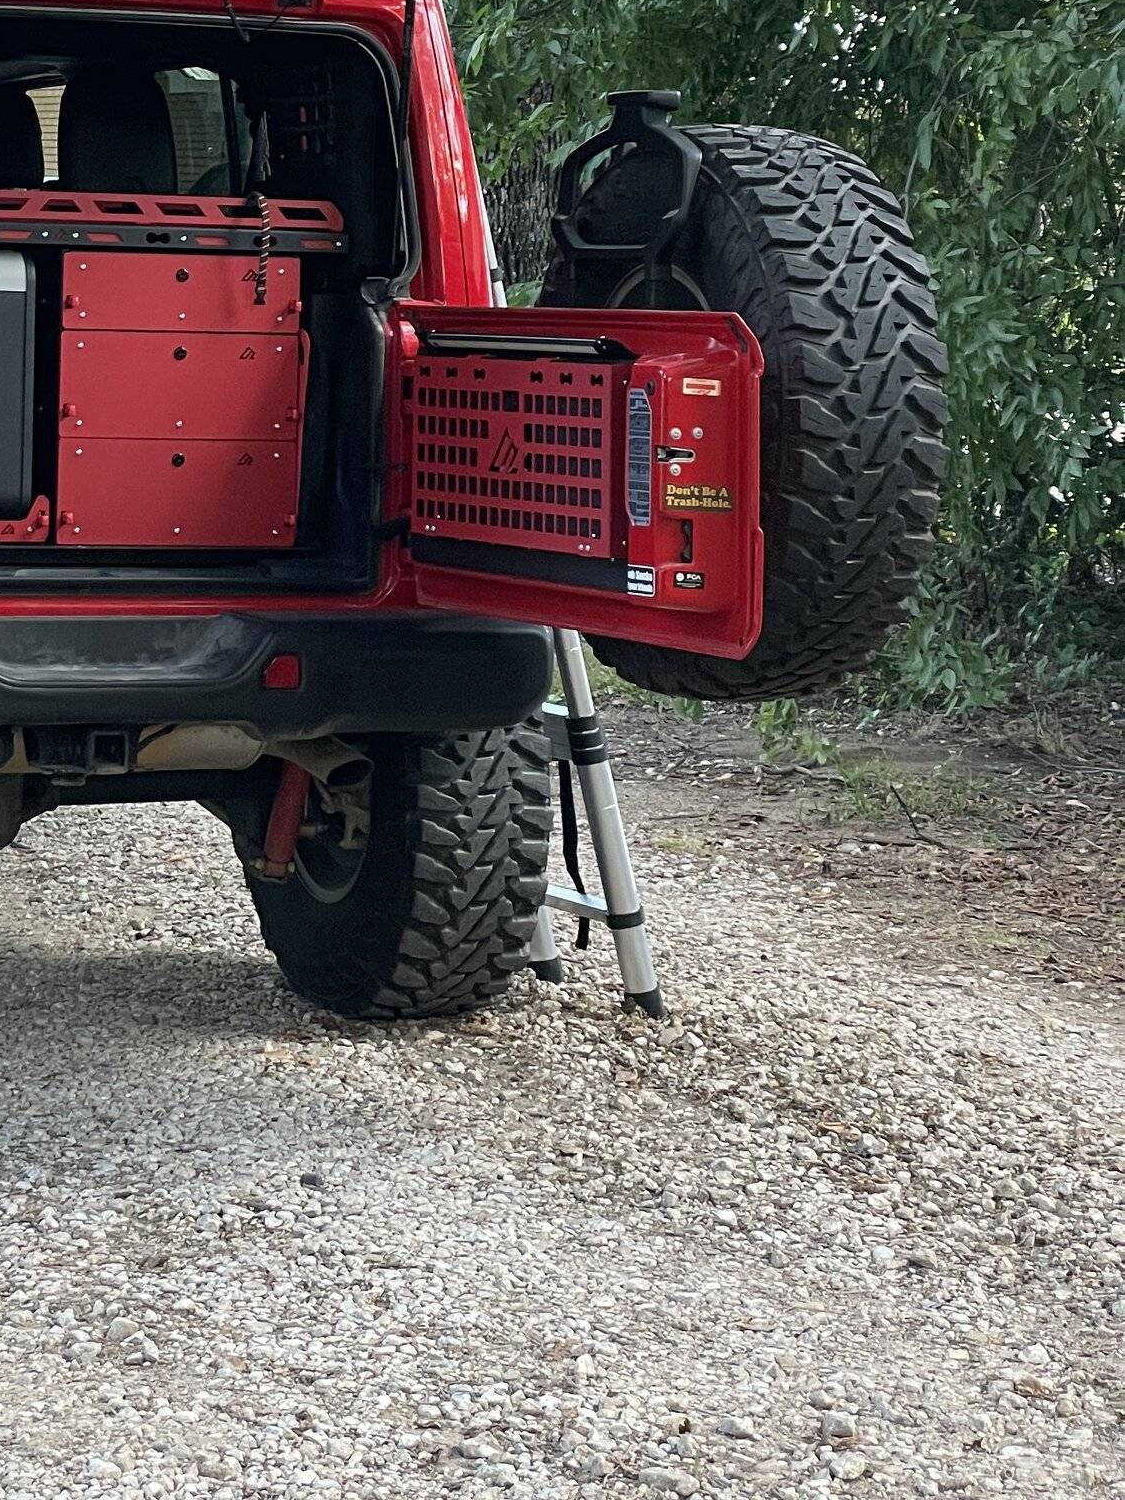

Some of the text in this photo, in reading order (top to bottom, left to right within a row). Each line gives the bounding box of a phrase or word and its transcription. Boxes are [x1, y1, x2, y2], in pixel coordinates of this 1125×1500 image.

[666, 484, 728, 497] Don't Be A
[665, 496, 732, 508] Trash-Hole.
